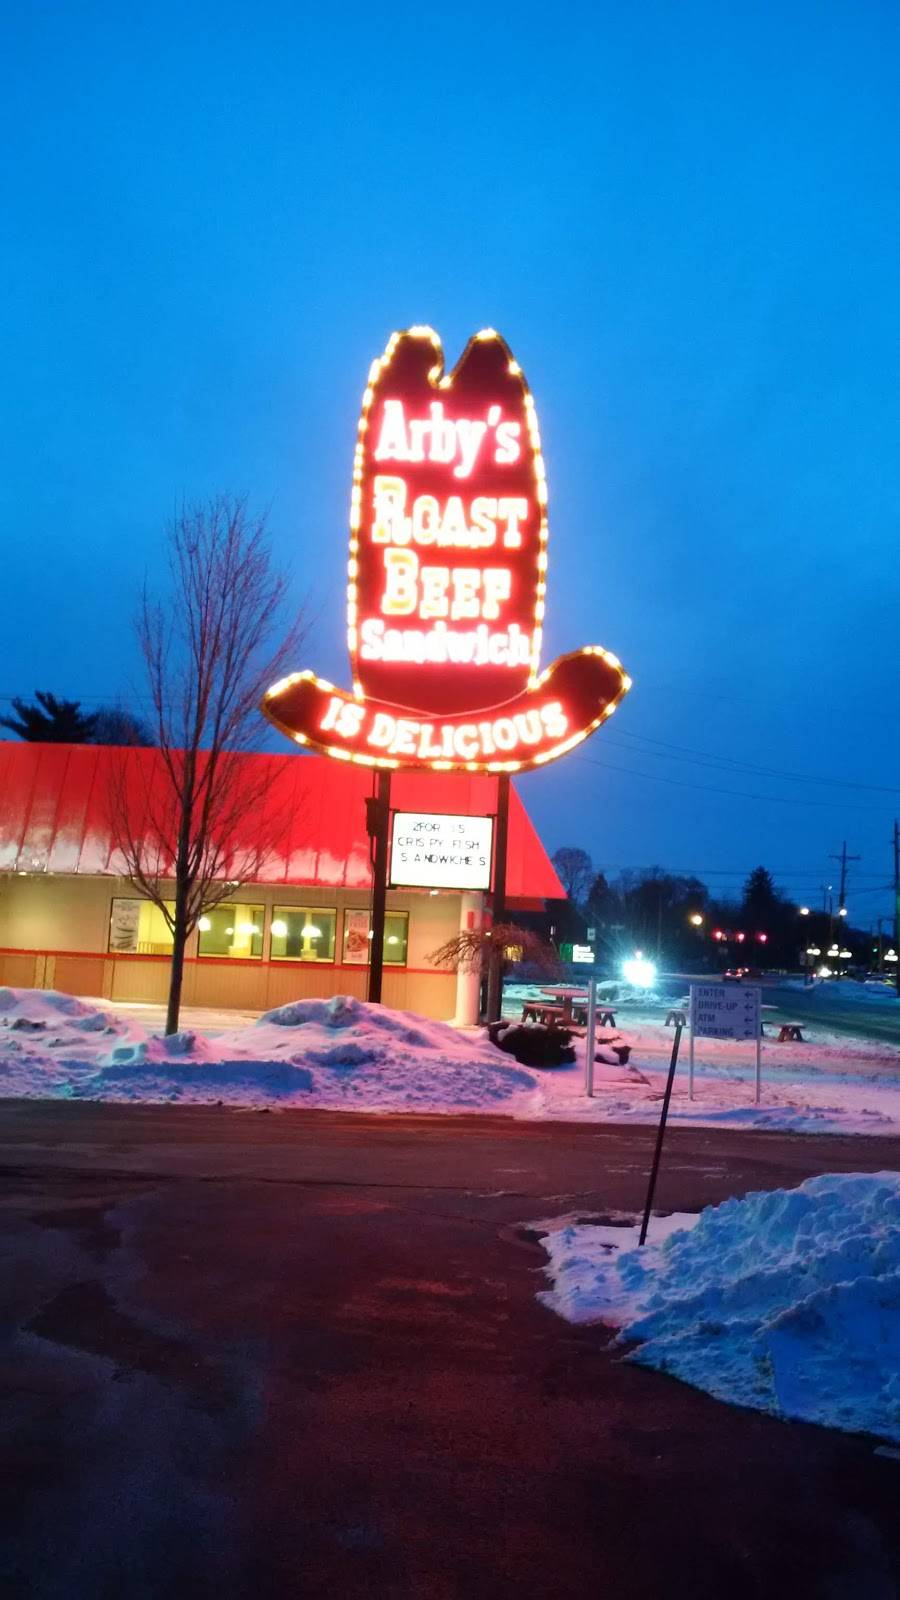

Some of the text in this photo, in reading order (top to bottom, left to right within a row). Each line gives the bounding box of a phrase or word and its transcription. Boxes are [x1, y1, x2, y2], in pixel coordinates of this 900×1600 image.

[374, 401, 520, 478] Arby's
[372, 476, 529, 550] ROAST
[381, 548, 511, 619] BEEF
[361, 619, 532, 665] Sandwich
[319, 697, 569, 760] IS DELICIOUS
[452, 839, 480, 850] FISH
[698, 988, 725, 997] ENTER
[698, 1000, 738, 1010] DRIVE-UP
[698, 1014, 715, 1022] ATM
[698, 1027, 734, 1036] PARKING
